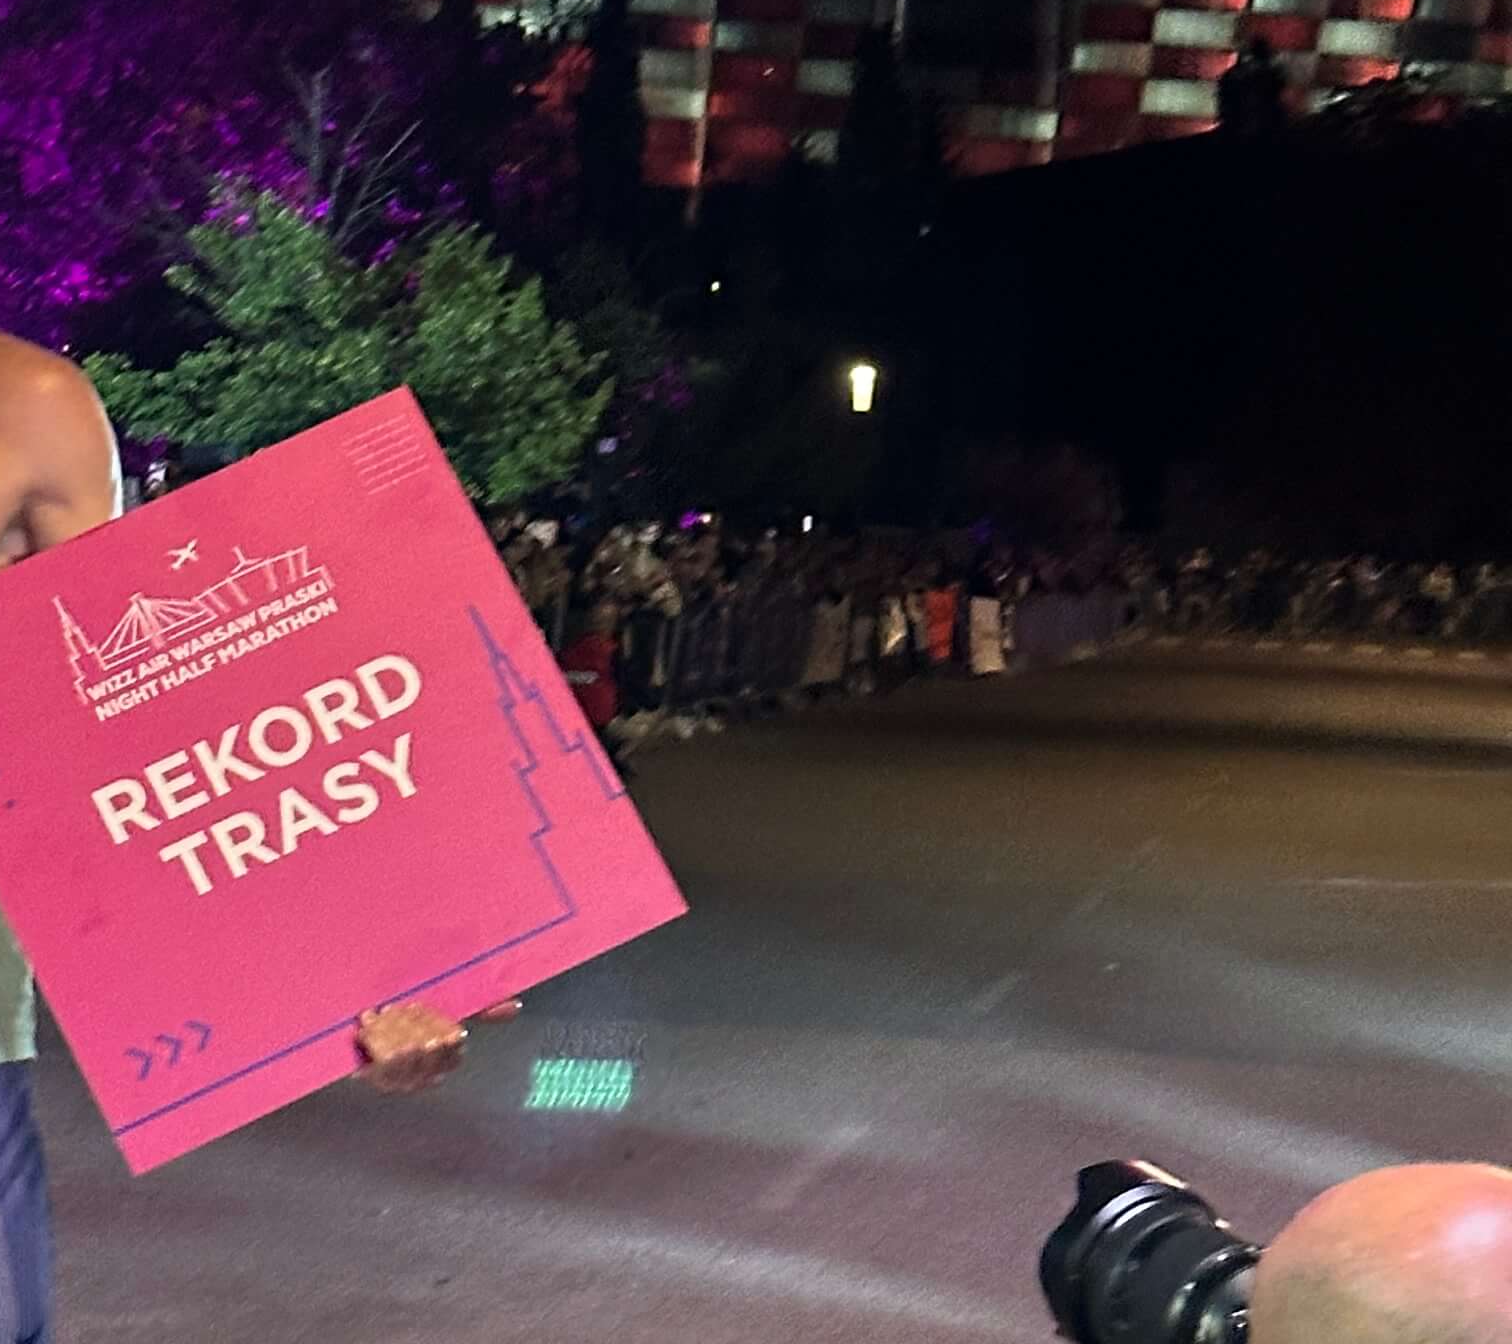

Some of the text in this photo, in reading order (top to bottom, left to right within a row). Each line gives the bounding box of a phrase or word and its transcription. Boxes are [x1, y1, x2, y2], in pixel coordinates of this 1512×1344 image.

[86, 579, 328, 700] WIZZ AIR WARSAW PRASKI
[94, 598, 338, 722] NIGHT HALF MARATHON
[91, 655, 422, 845] REKORD
[158, 732, 417, 896] TRASY
